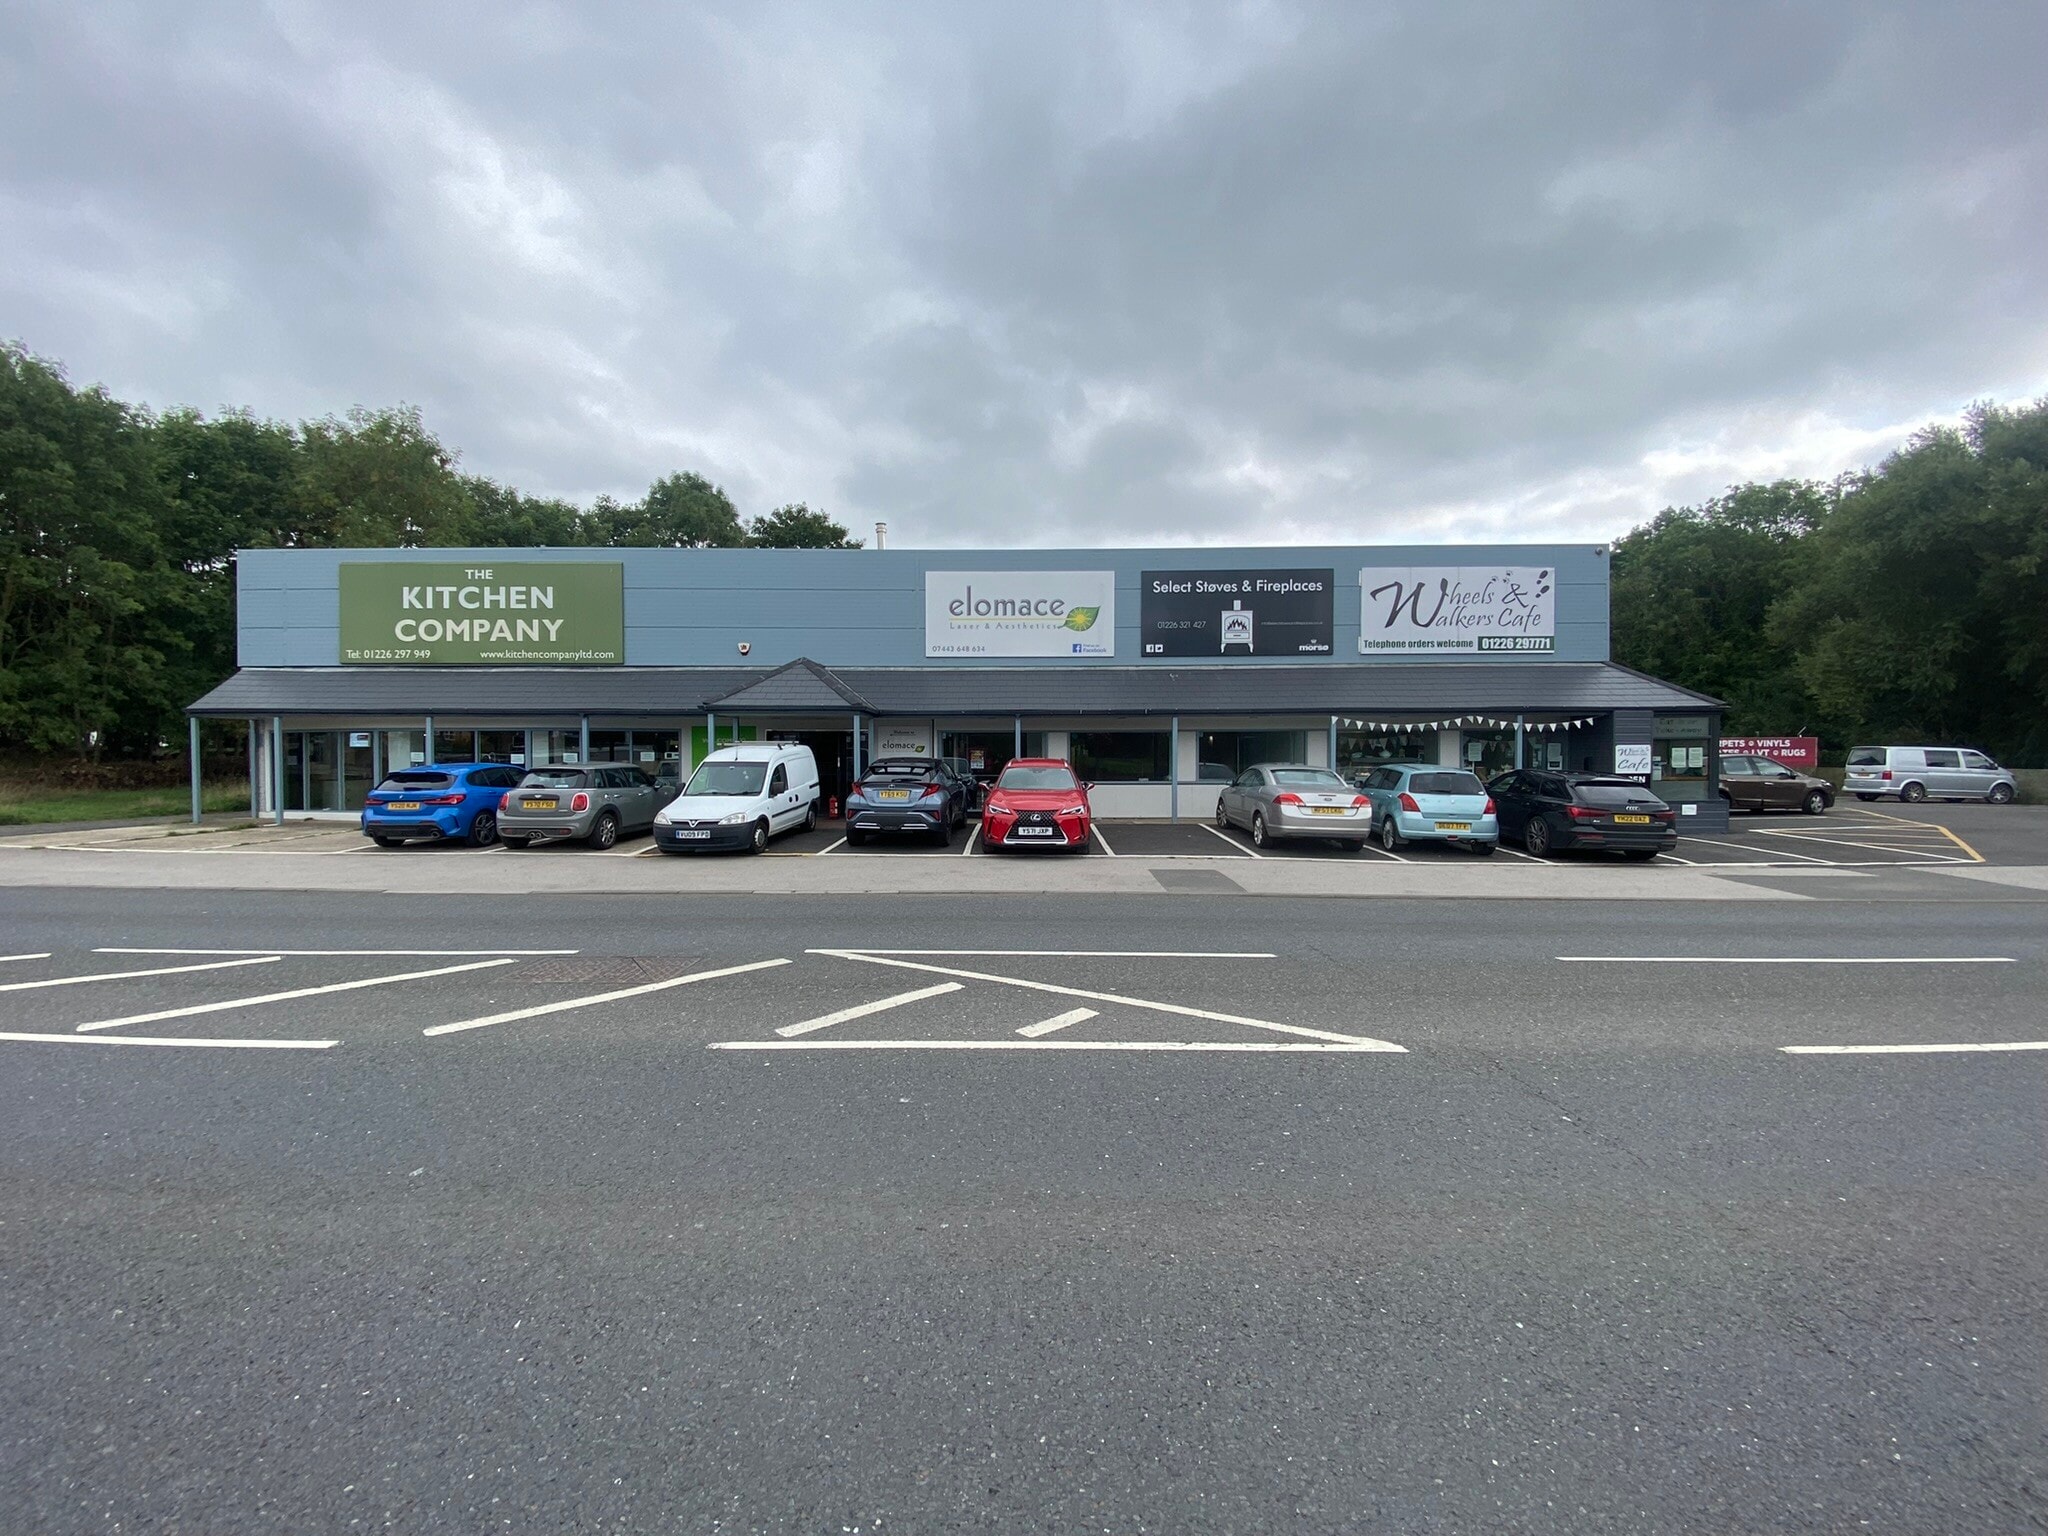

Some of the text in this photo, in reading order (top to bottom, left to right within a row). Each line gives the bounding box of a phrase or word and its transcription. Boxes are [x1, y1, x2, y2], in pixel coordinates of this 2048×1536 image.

[465, 569, 493, 580] THE
[1152, 578, 1323, 595] Select Støves & Fireplaces
[402, 586, 554, 609] KITCHEN
[949, 585, 1065, 617] elomace
[1502, 583, 1528, 608] &
[1498, 604, 1542, 633] Cafe
[394, 618, 564, 642] COMPANY
[950, 622, 980, 630] Laser
[995, 622, 1057, 630] Aesthetics
[1157, 620, 1207, 630] 01226 321 427
[1363, 639, 1474, 649] Telephone orders welcome
[1481, 637, 1551, 649] 01226 297771
[346, 649, 431, 659] Tel: 01226 297 949
[480, 649, 615, 661] www.kitchencompanyltd.com
[881, 739, 916, 749] elomace
[1756, 739, 1791, 747] VINYLS
[1780, 749, 1807, 757] RUGS
